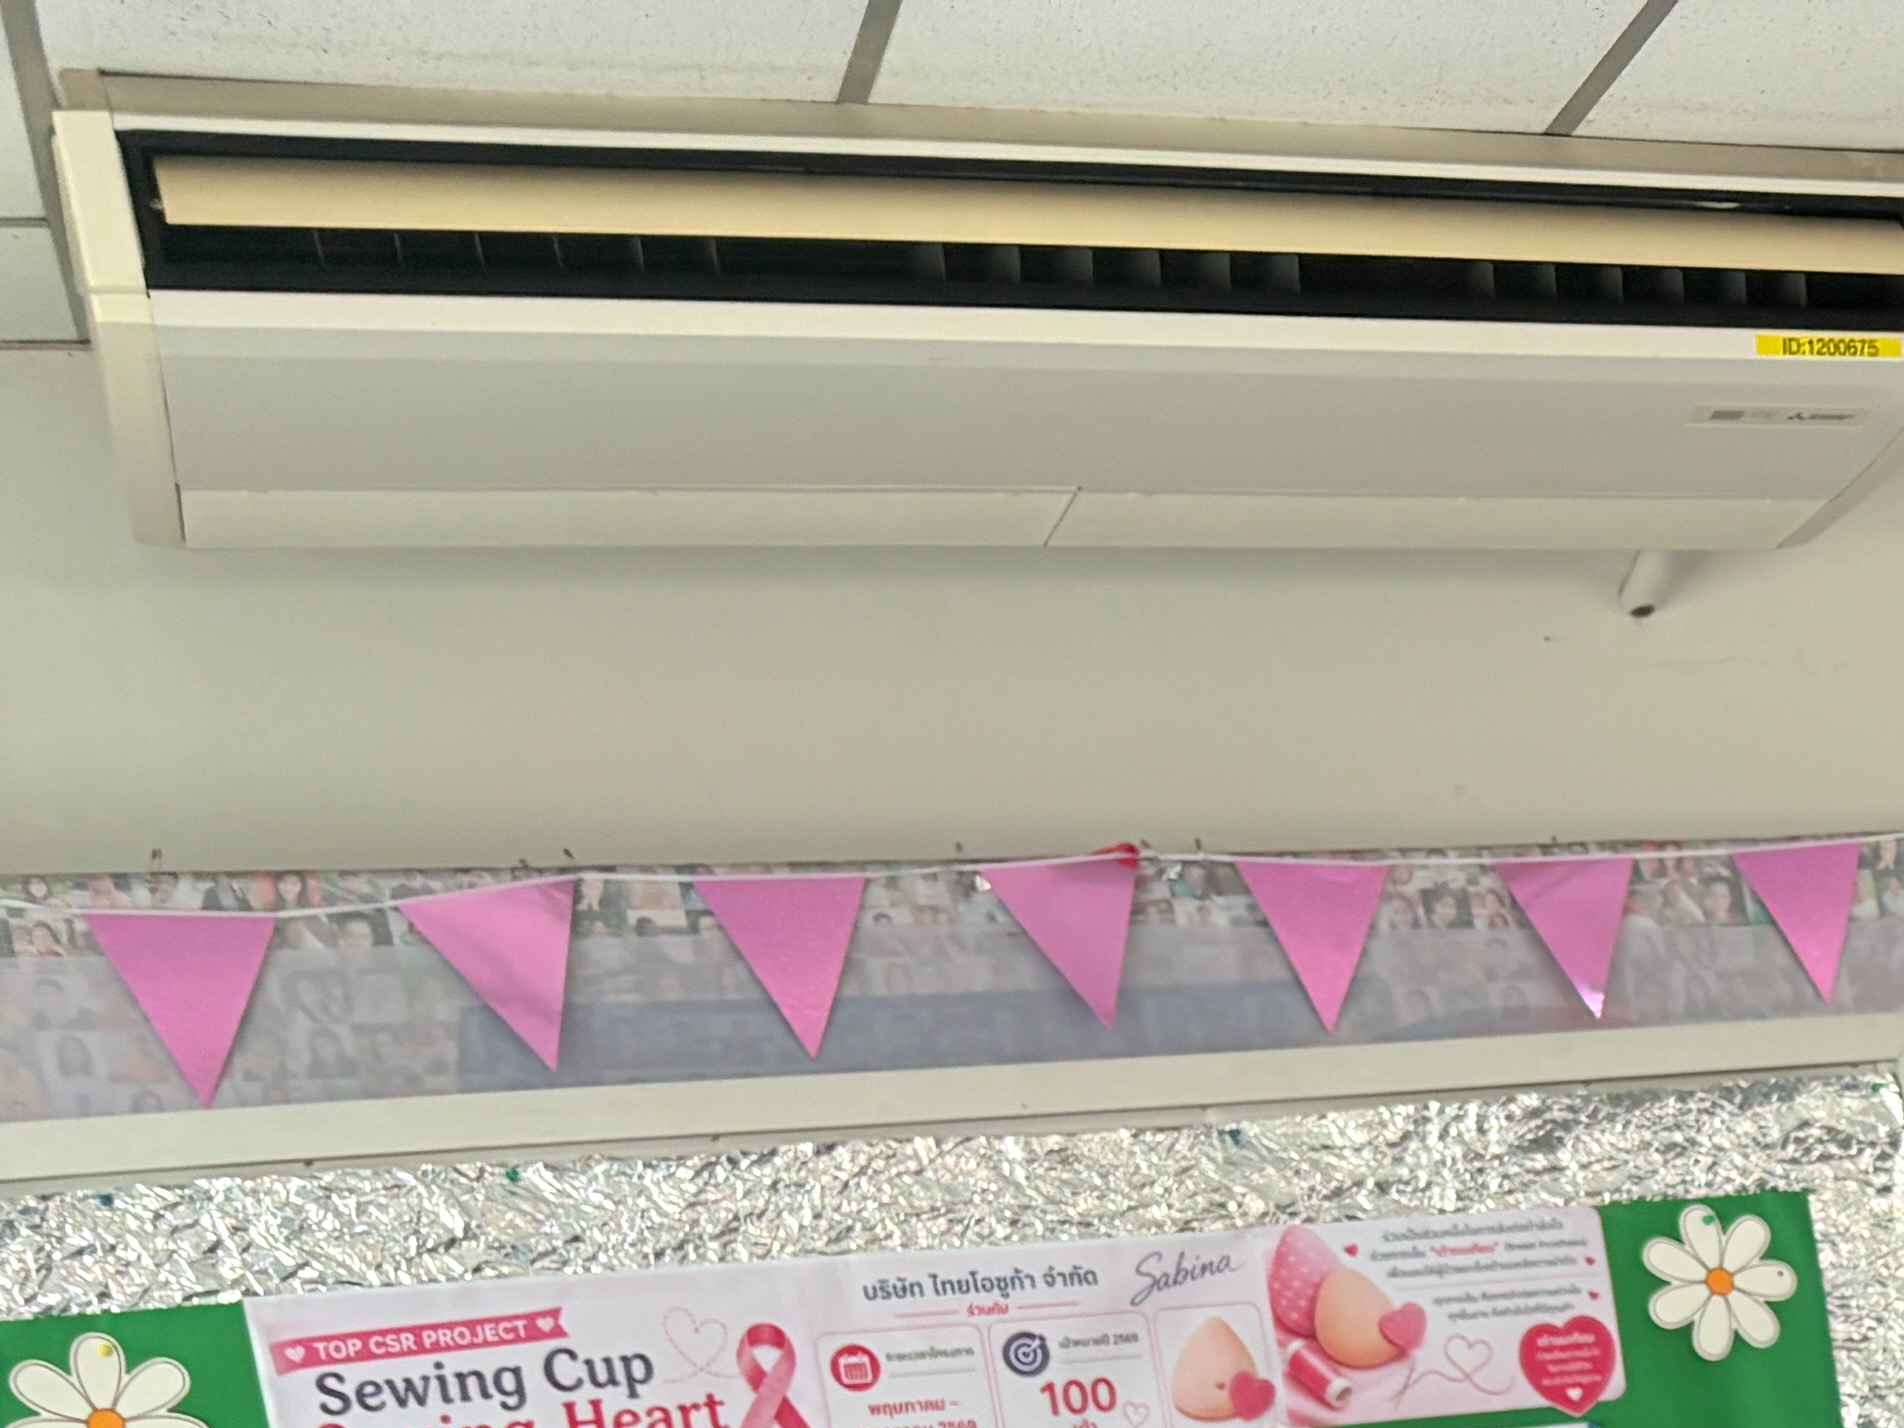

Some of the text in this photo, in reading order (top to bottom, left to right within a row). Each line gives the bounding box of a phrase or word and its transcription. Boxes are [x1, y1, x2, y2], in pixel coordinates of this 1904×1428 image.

[1781, 338, 1879, 357] ID:1200675
[863, 1274, 924, 1301] บริษัท
[1043, 1264, 1098, 1288] จำกัด
[1129, 1251, 1242, 1307] Sabina
[315, 1321, 529, 1361] TOP CSR PROJECT
[315, 1348, 655, 1416] Sewing Cup
[1039, 1377, 1117, 1417] 100
